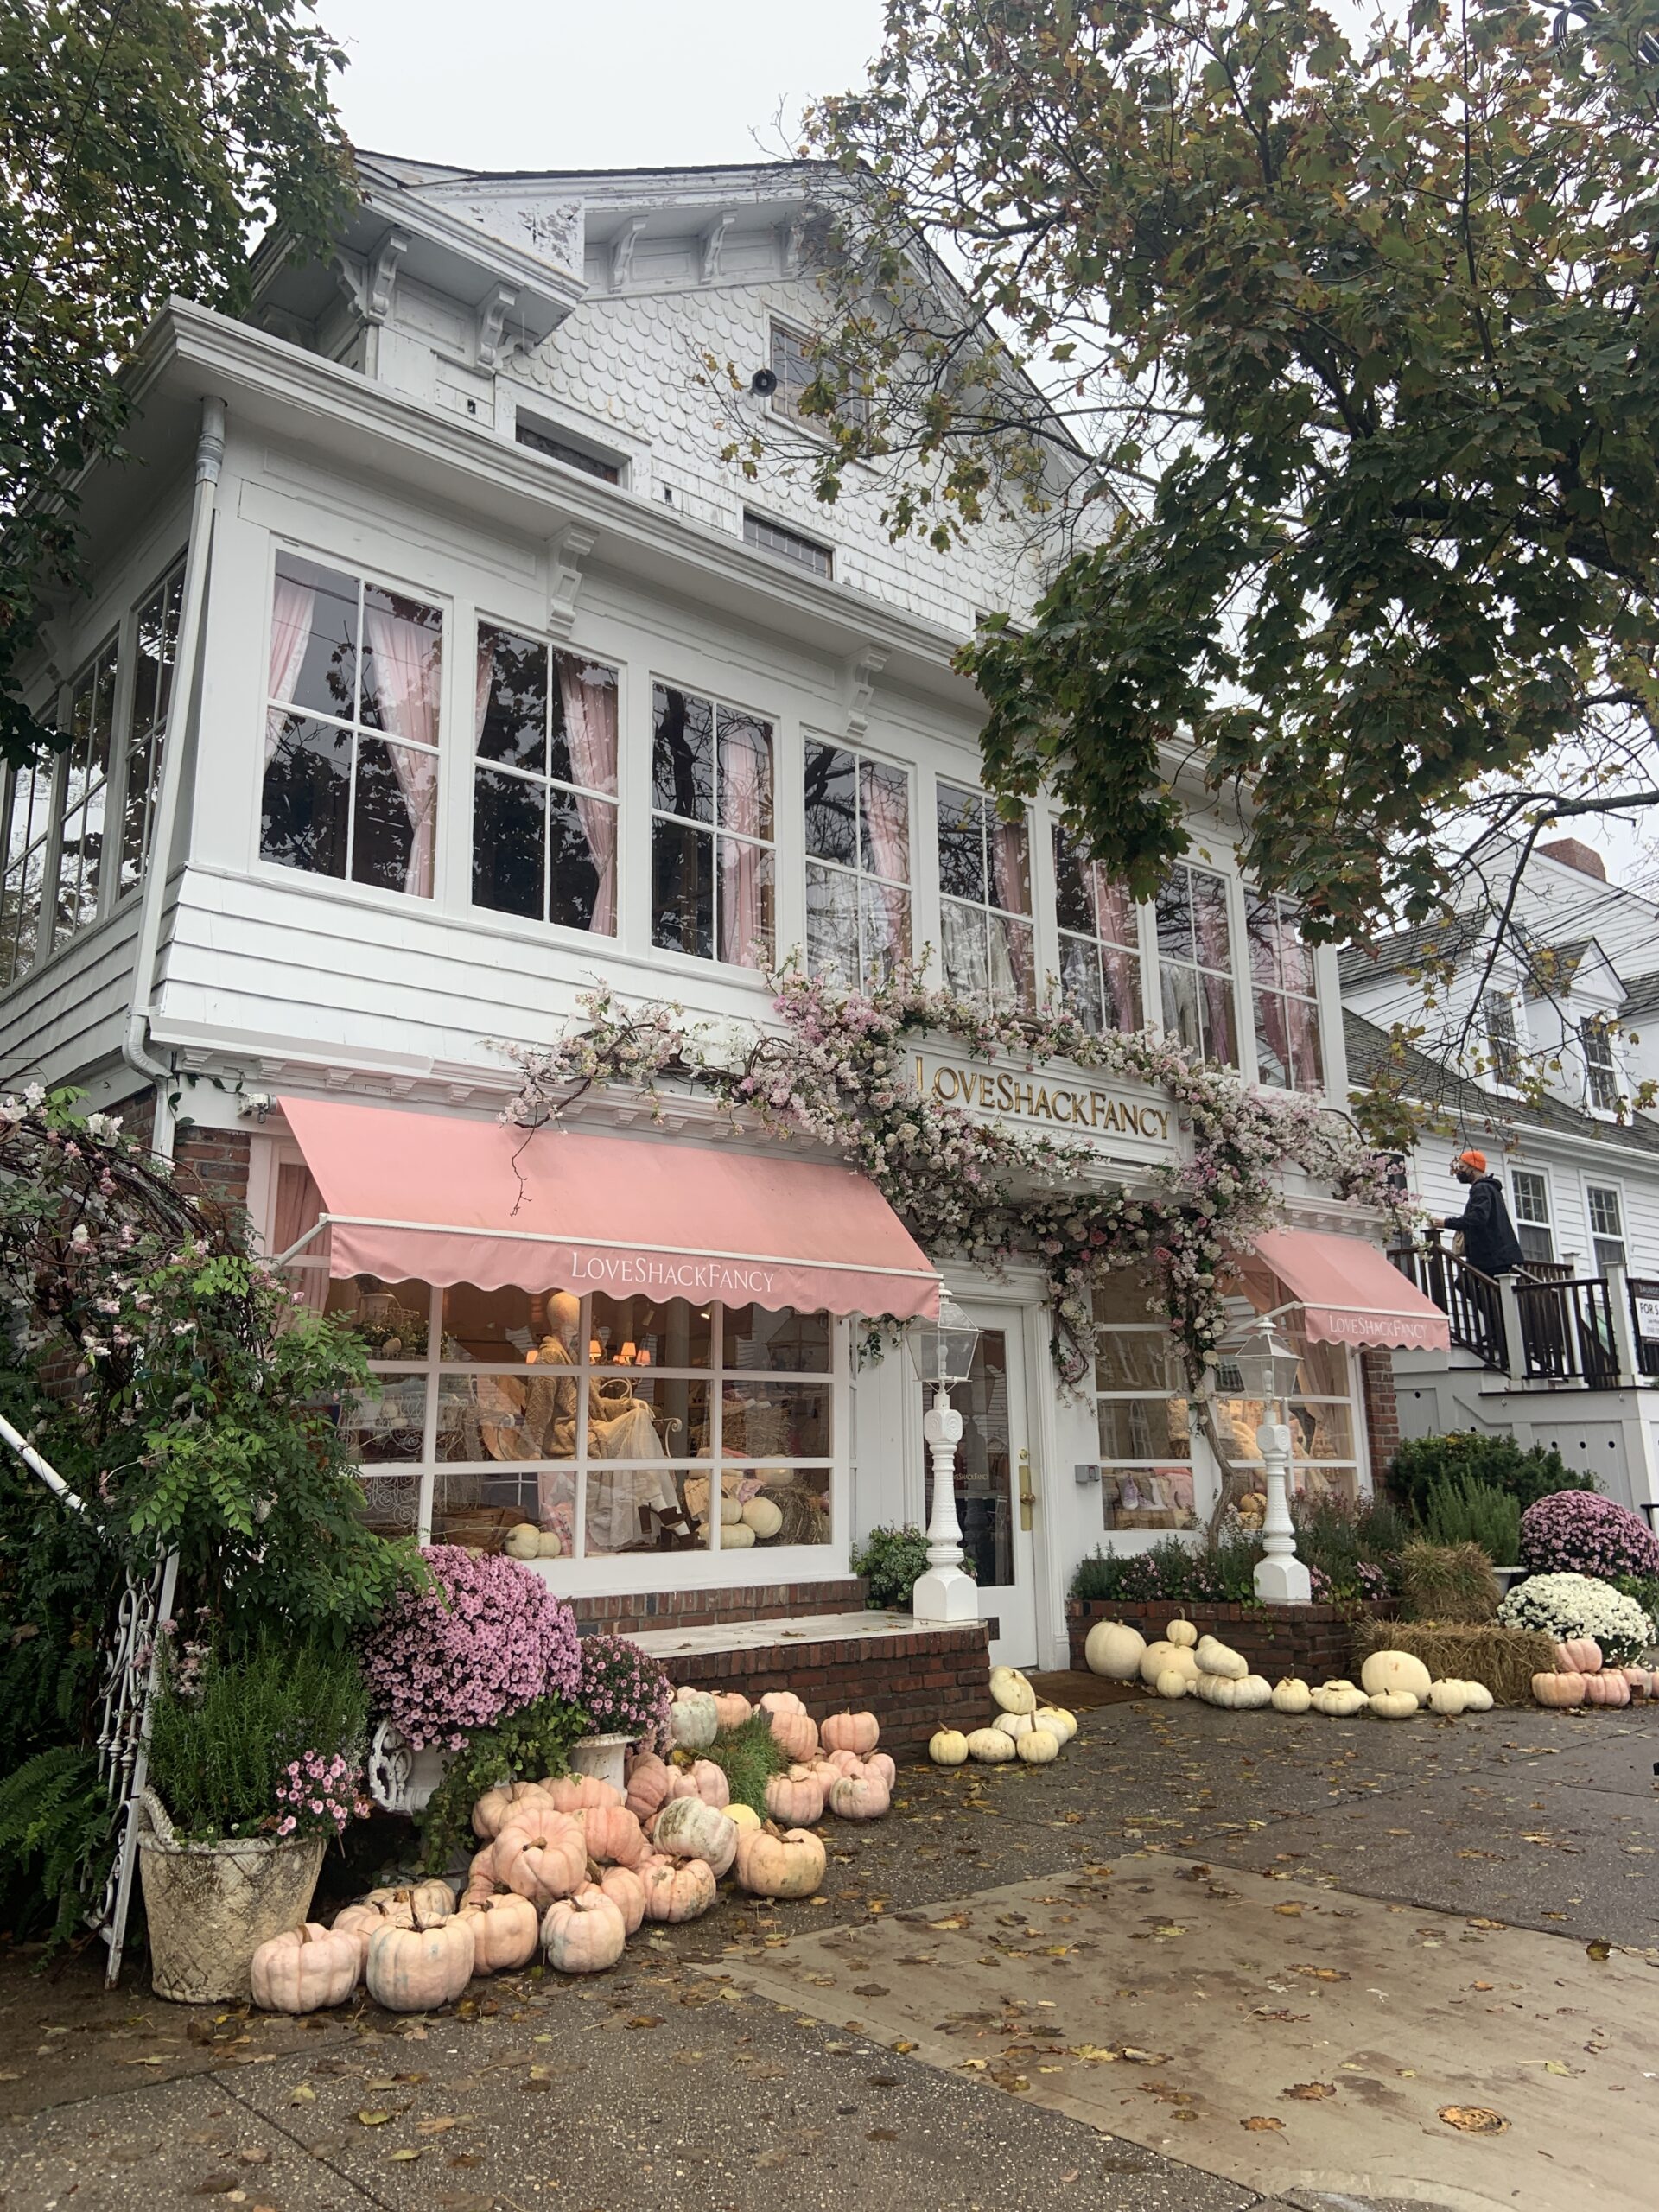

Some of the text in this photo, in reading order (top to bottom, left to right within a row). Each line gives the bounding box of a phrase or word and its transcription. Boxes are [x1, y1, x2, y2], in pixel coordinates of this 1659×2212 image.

[572, 1252, 774, 1293] LOVESHACKFANCY
[1640, 1302, 1654, 1314] FOR
[1329, 1315, 1427, 1338] LOVESHACKFANCY
